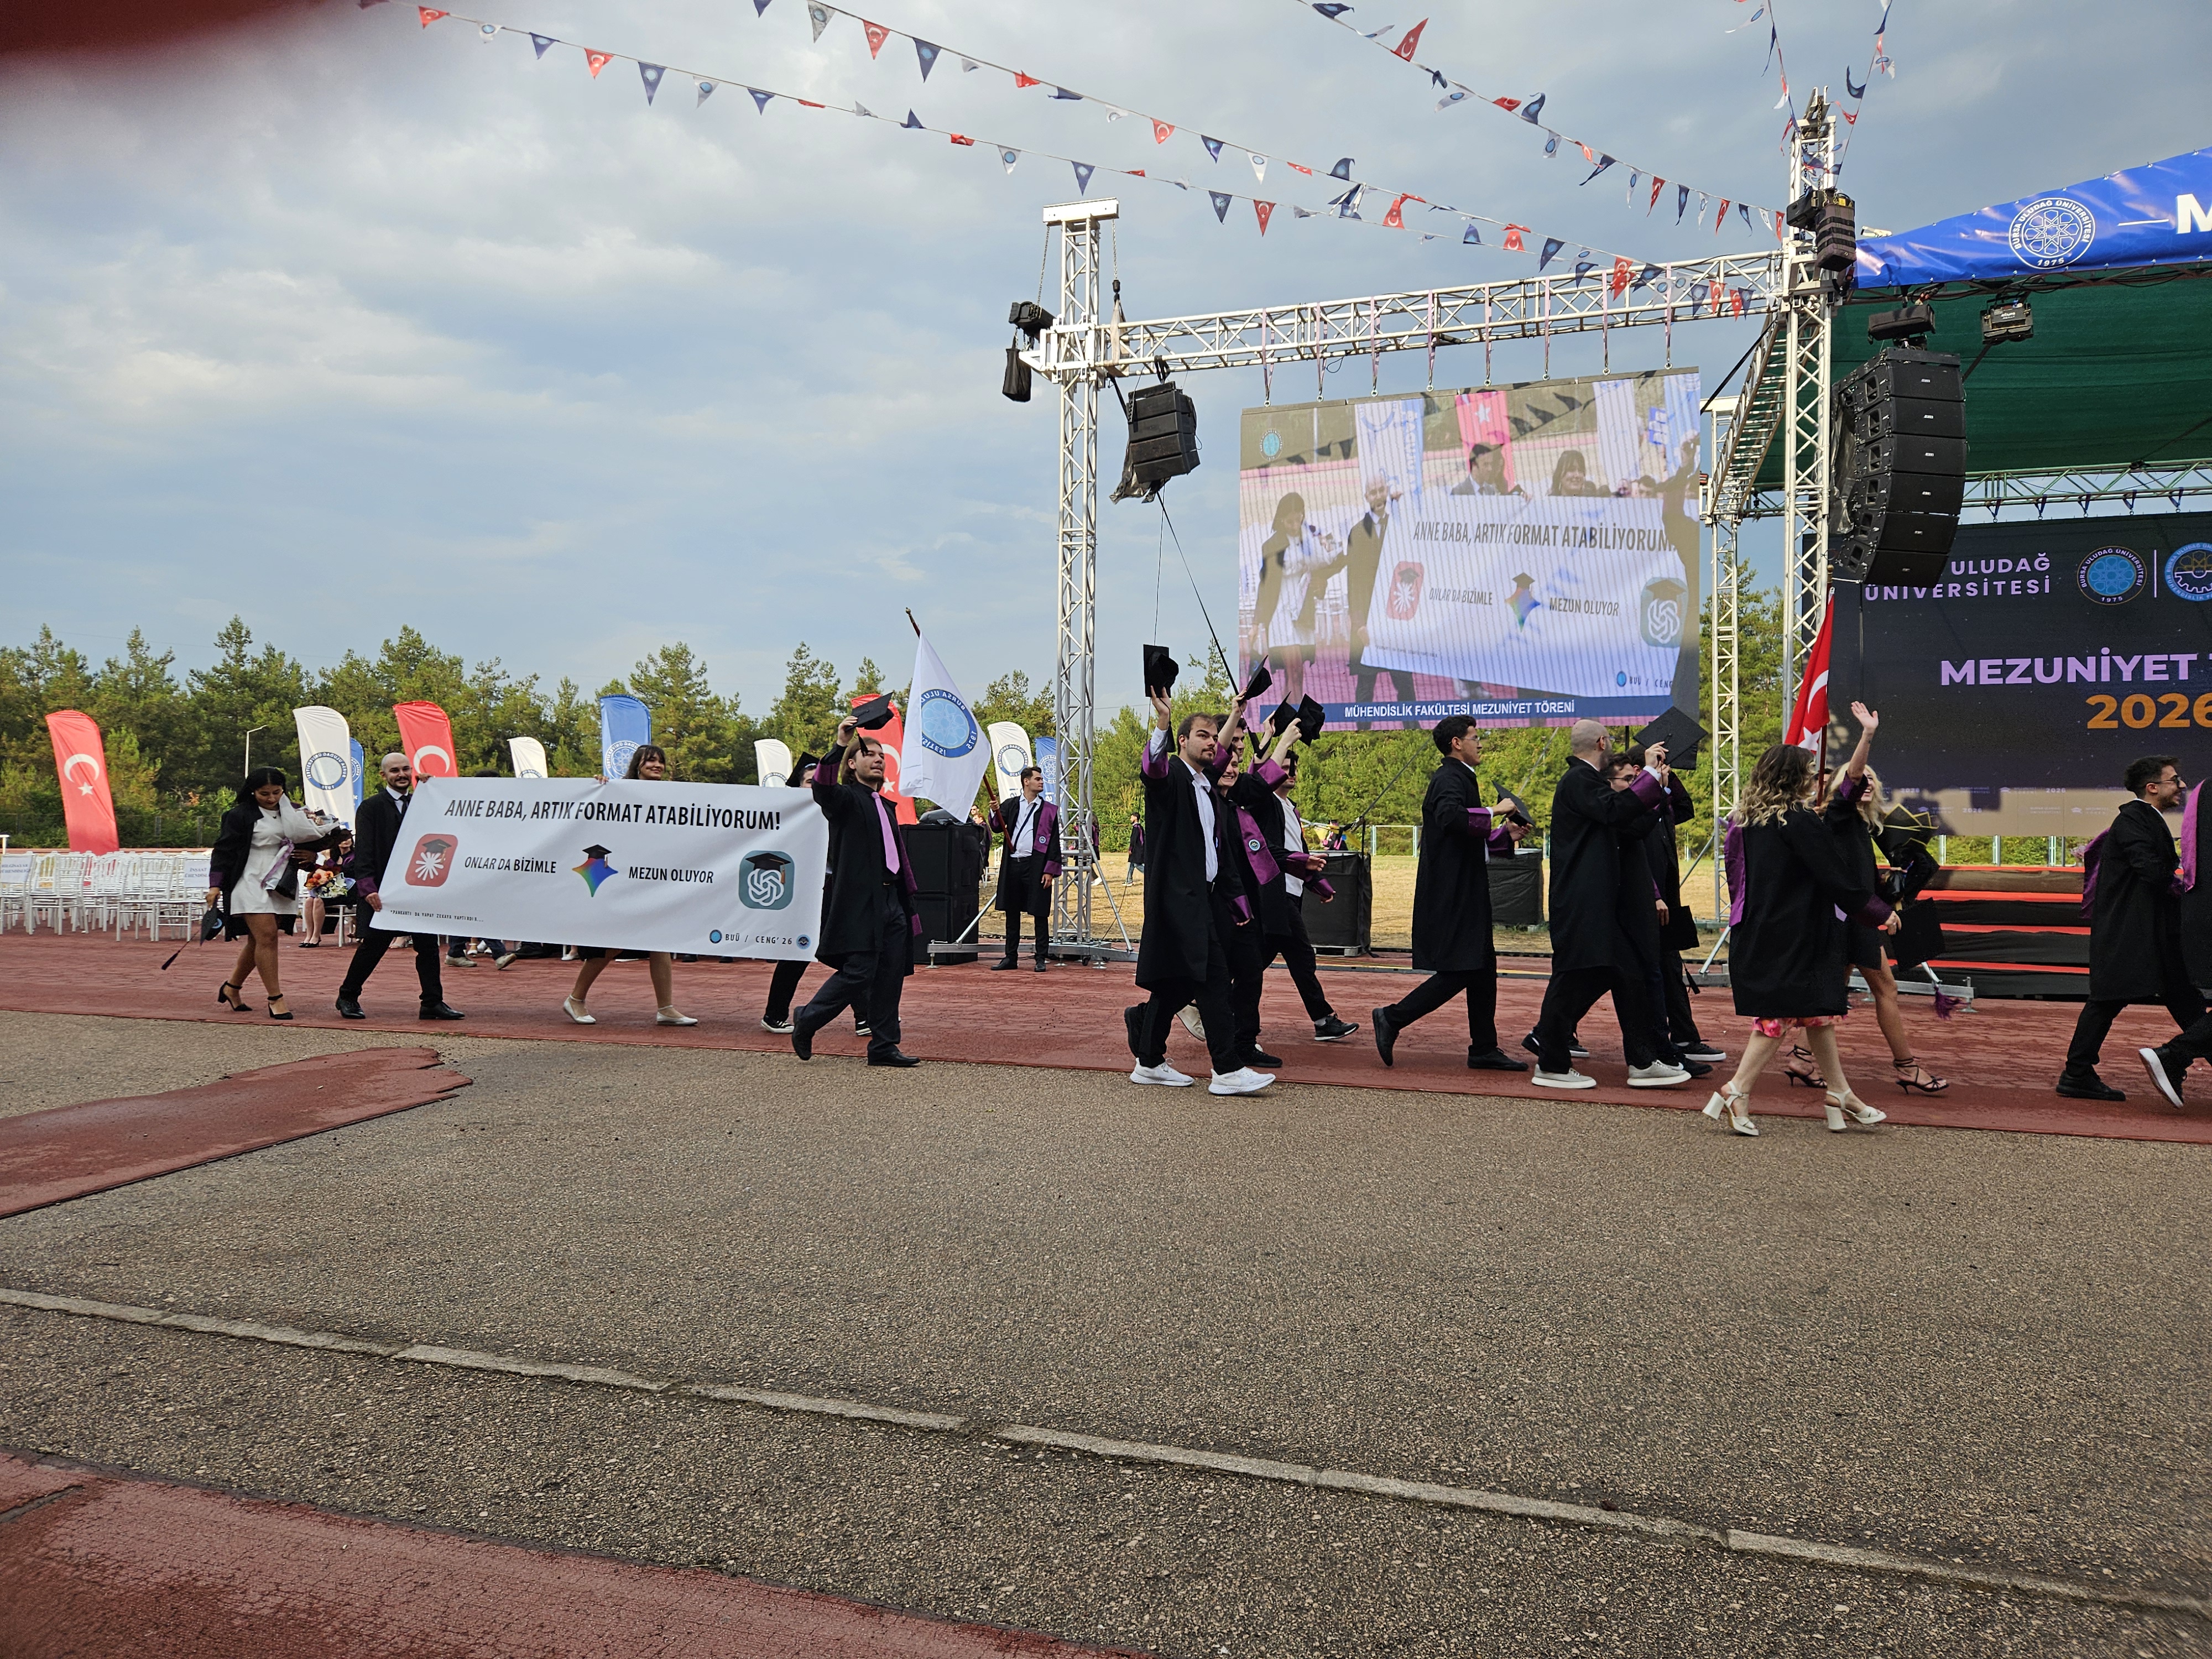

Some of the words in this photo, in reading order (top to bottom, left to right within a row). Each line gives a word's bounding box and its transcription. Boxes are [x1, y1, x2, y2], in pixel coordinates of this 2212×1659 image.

[2012, 223, 2022, 249] BURSA
[2018, 200, 2053, 222] ULUDAĞ
[2037, 258, 2064, 266] 1975
[1413, 521, 1440, 541] ANNE
[1442, 523, 1472, 546] BABA,
[1474, 523, 1507, 544] ARTIK
[1507, 524, 1559, 546] FORMAT
[1951, 552, 2050, 575] ULUDAĞ
[2085, 548, 2113, 565] ULUDAĞ
[1429, 588, 1451, 602] ONLAR
[1462, 587, 1493, 605] BİZİMLE
[1550, 597, 1581, 613] MEZUN
[1584, 600, 1619, 616] OLUYOR
[1941, 647, 2198, 686] MEZUNİYET
[1344, 703, 1412, 717] MÜHENDİSLİK
[1415, 701, 1470, 716] FAKÜLTESİ
[1473, 700, 1532, 714] MEZUNİYET
[1535, 699, 1574, 713] TÖRENİ
[2085, 693, 2212, 729] 2026
[444, 800, 484, 817] ANNE
[486, 801, 527, 821] BABA,
[530, 801, 575, 820] ARTIK
[575, 802, 642, 822] FORMAT
[645, 803, 780, 830] ATABİLİYORUM!
[464, 856, 497, 870] ONLAR
[497, 858, 511, 870] DA
[513, 857, 557, 873] BİZİMLE
[628, 866, 667, 881] MEZUN
[670, 868, 713, 883] OLUYOR
[725, 933, 740, 941] BUÜ
